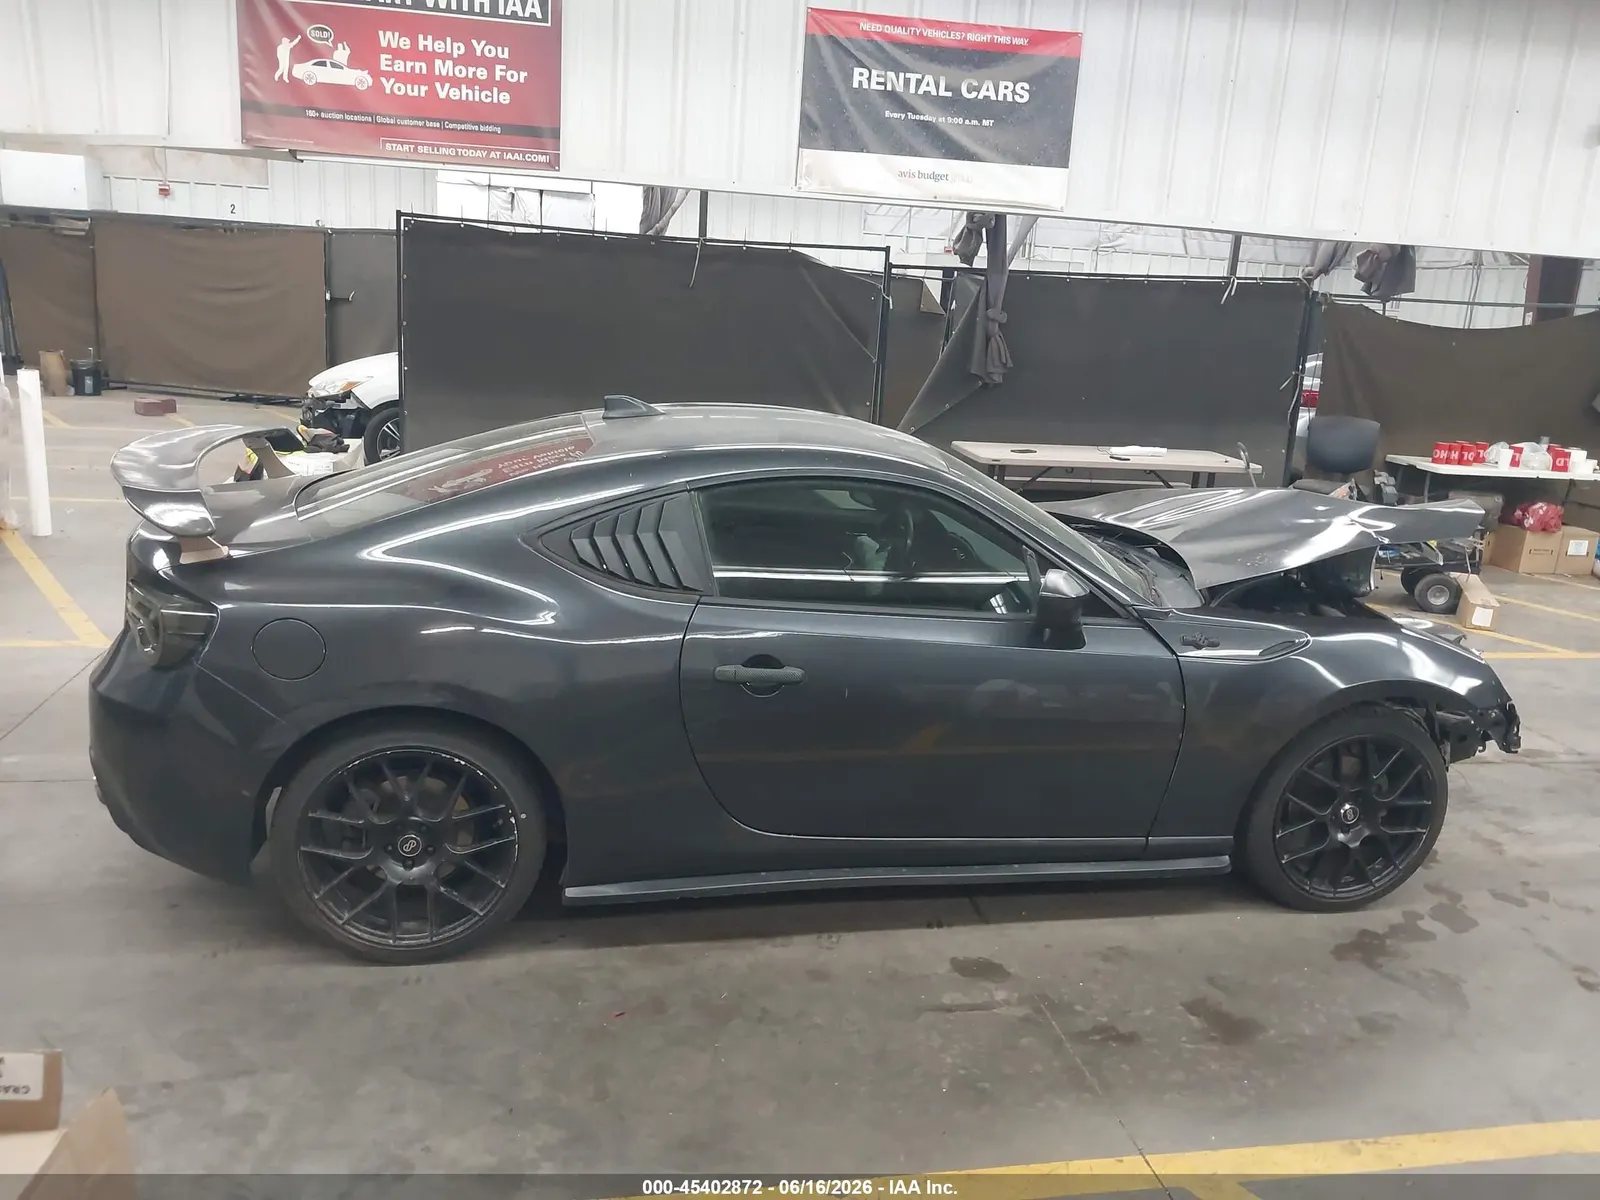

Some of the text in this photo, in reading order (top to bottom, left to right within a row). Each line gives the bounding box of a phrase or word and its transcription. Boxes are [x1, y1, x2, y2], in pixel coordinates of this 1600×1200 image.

[498, 0, 542, 19] IAA
[310, 29, 331, 39] SOLD!
[859, 22, 883, 32] NEED
[884, 25, 921, 36] QUALITY
[922, 28, 966, 40] VEHICLES?
[966, 32, 992, 43] RIGHT
[993, 35, 1011, 45] THIS
[378, 30, 509, 59] We Help You
[380, 53, 528, 83] Earn More For
[380, 76, 511, 105] Your Vehicle
[852, 67, 1030, 103] RENTAL CARS
[320, 111, 343, 121] auction
[344, 112, 372, 122] locations
[376, 115, 396, 125] Global
[397, 118, 425, 127] customer
[425, 119, 440, 128] base
[444, 121, 479, 132] Competitive
[479, 124, 501, 134] bidding
[884, 110, 905, 121] Every
[907, 112, 937, 123] Tuesday
[938, 115, 946, 123] at
[981, 119, 995, 127] MT
[385, 142, 415, 153] START
[417, 145, 456, 156] SELLING
[456, 148, 487, 159] TODAY
[489, 150, 501, 160] AT
[897, 169, 916, 179] avis
[917, 168, 949, 183] budget
[230, 203, 236, 214] 2
